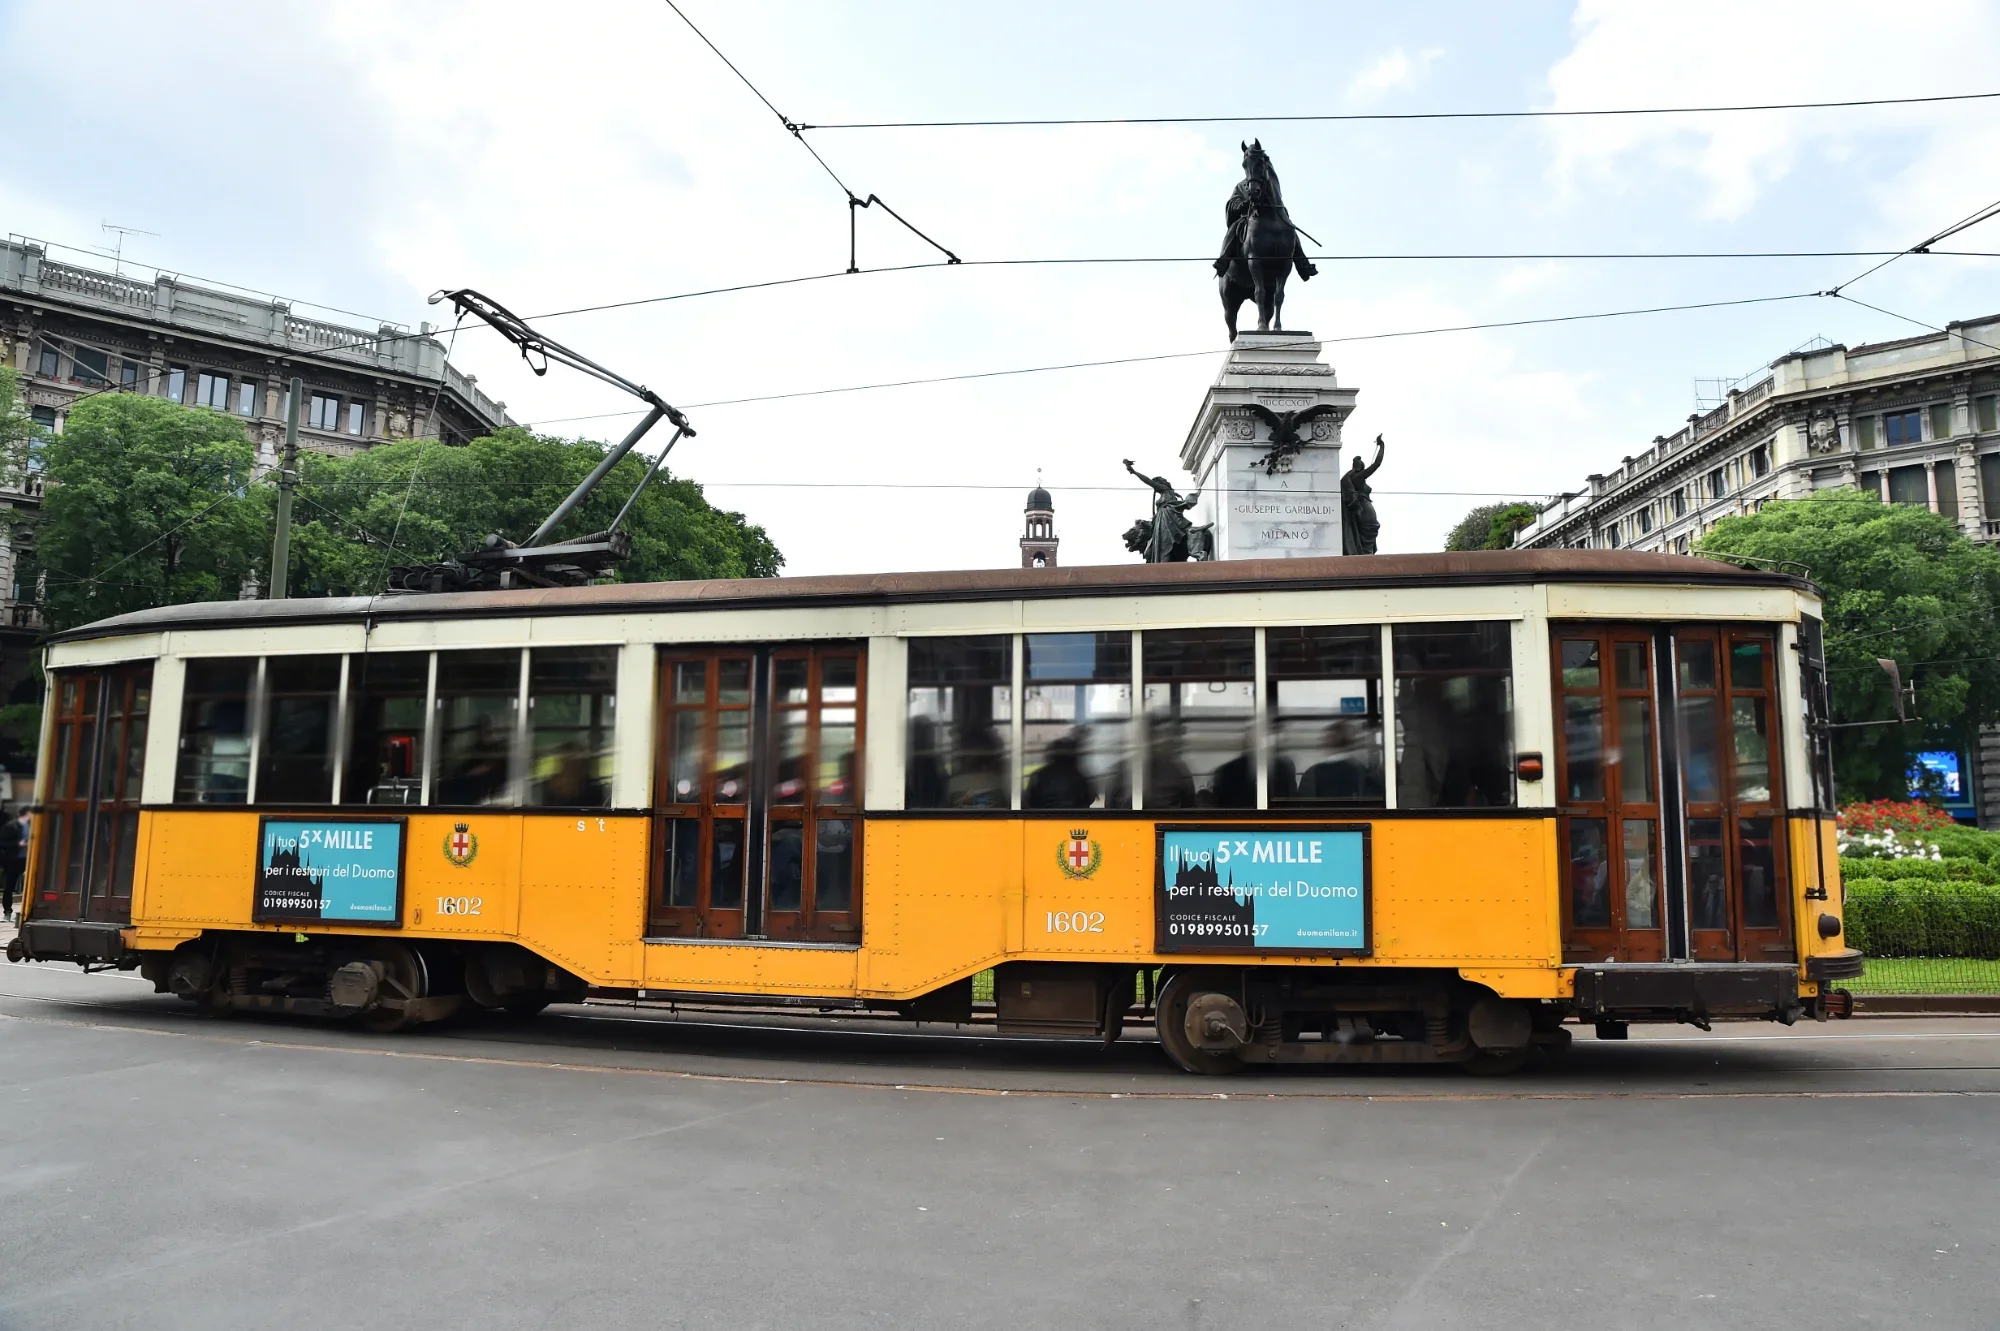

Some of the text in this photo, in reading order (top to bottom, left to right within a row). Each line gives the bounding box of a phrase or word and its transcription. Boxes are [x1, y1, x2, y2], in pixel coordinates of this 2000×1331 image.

[1280, 480, 1289, 489] A
[1261, 530, 1309, 540] MILANO
[277, 835, 297, 848] tuo
[1169, 845, 1179, 862] Il
[1184, 847, 1211, 863] tuo
[265, 865, 284, 879] per
[291, 865, 330, 877] restauri
[332, 863, 350, 877] del
[352, 864, 395, 879] Duomo
[1169, 884, 1195, 900] per
[1208, 882, 1264, 897] restauri
[1268, 880, 1292, 898] del
[1296, 880, 1358, 898] Duomo
[263, 898, 332, 910] 01989950157
[435, 896, 483, 916] 1602
[1046, 911, 1106, 933] 1602
[1169, 914, 1237, 922] CODICE FISCALE
[1169, 923, 1358, 938] 01989950157 duomomilano.it
